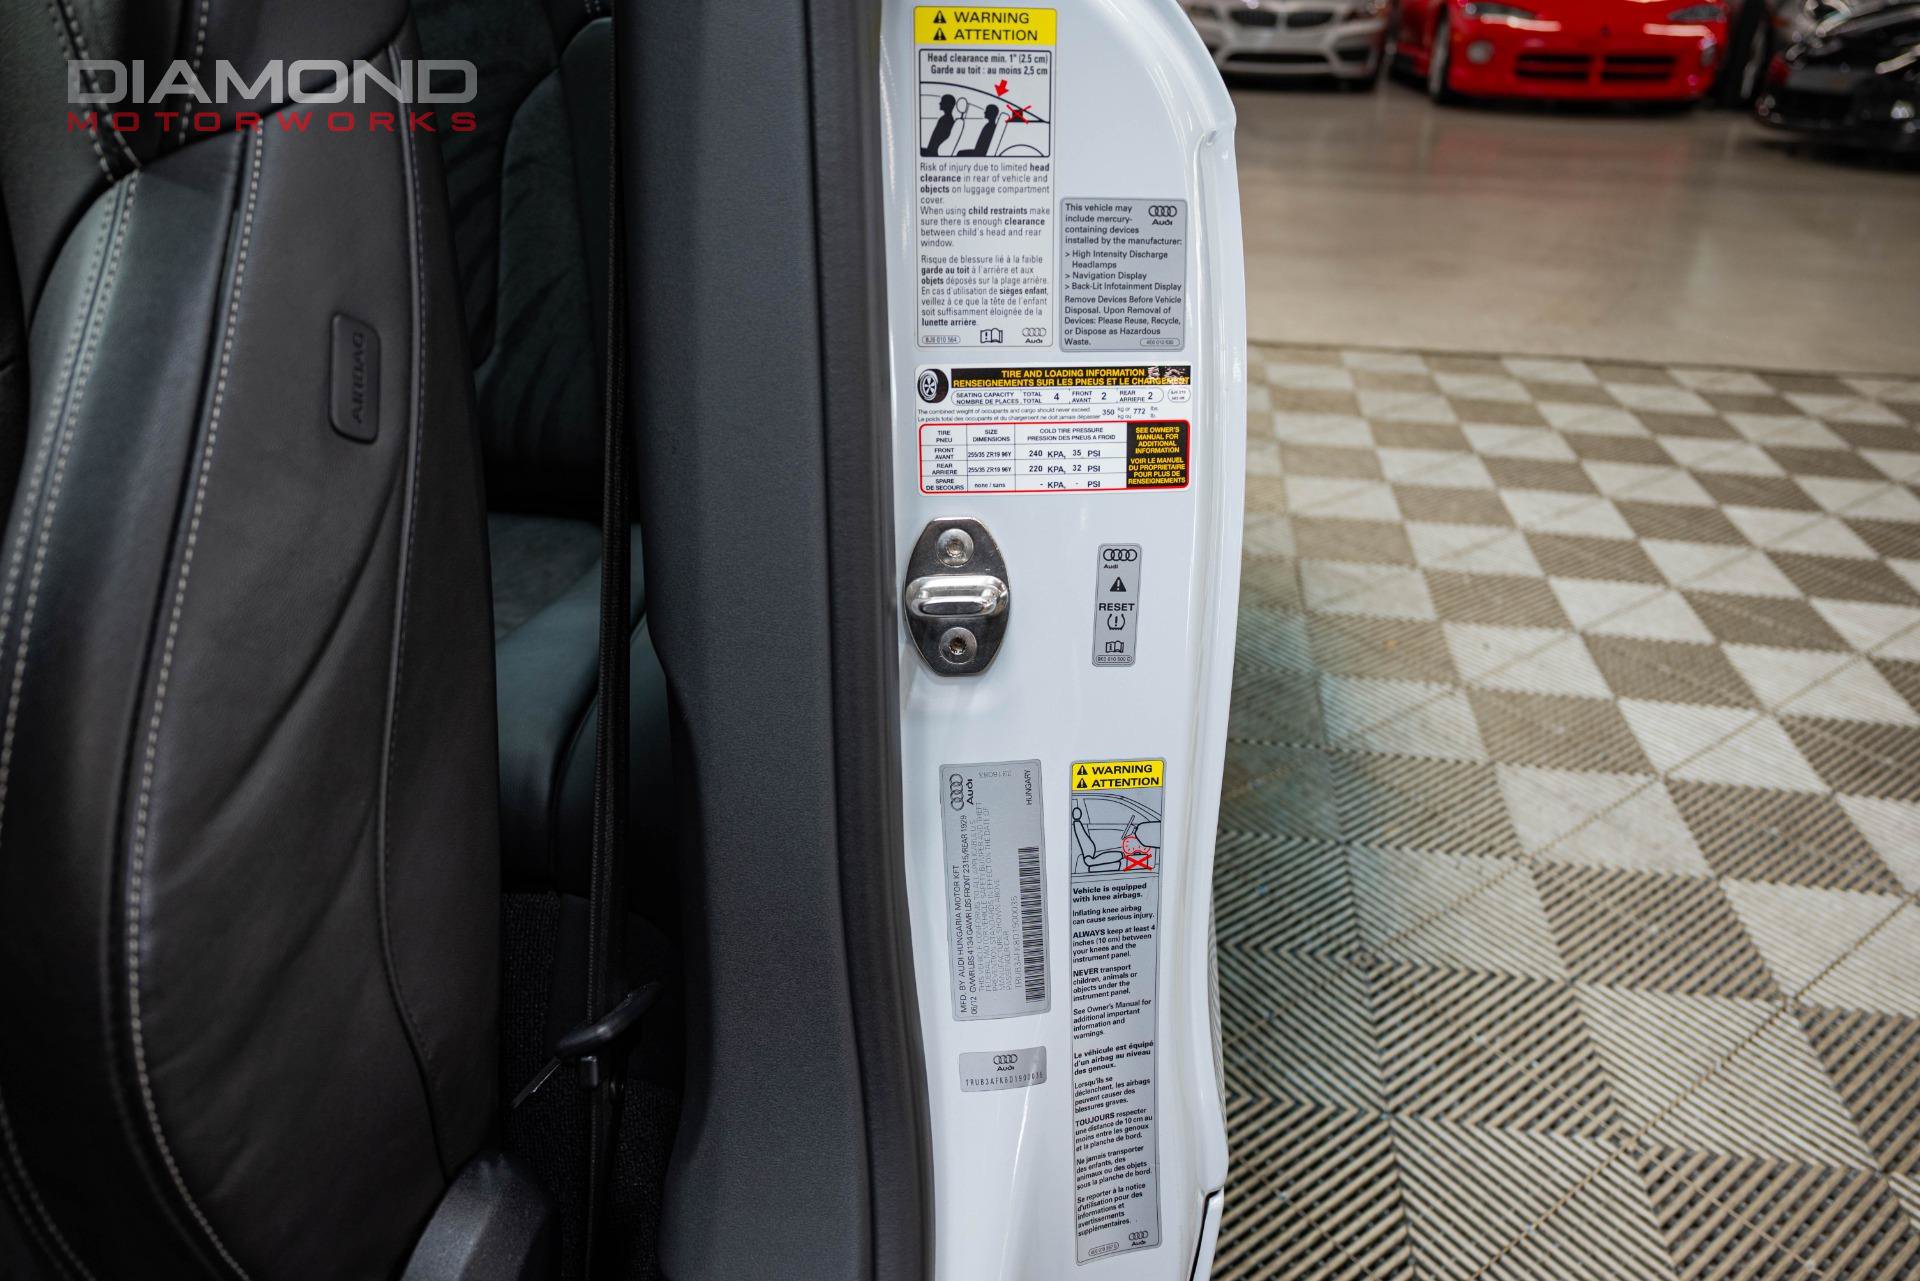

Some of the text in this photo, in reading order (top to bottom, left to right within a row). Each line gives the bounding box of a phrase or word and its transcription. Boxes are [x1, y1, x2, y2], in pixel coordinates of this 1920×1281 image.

[954, 12, 1029, 24] WARNING
[954, 29, 1038, 40] ATTENTION
[928, 54, 948, 62] Head
[950, 54, 989, 63] clearance
[991, 54, 1008, 63] min.
[1034, 55, 1048, 64] cm)
[931, 66, 954, 74] Garde
[968, 66, 980, 74] toit
[1000, 66, 1022, 75] moins
[920, 162, 936, 171] Risk
[939, 162, 947, 171] of
[949, 163, 971, 173] injury
[1001, 163, 1027, 171] limited
[920, 185, 949, 194] objects
[964, 185, 995, 195] luggage
[998, 186, 1049, 195] compartment
[1072, 251, 1168, 259] High Intensity Discharge
[1065, 307, 1100, 315] Disposal.
[1076, 328, 1106, 336] Dispose
[1045, 370, 1084, 378] LOADING
[1092, 765, 1152, 774] WARNING
[1092, 777, 1159, 787] ATTENTION
[1024, 769, 1032, 805] HUNGARY
[1112, 883, 1146, 892] equipped
[954, 880, 962, 911] MOTOR
[1073, 929, 1105, 938] ALWAYS
[1073, 965, 1131, 977] NEVER transport
[959, 981, 966, 990] BY
